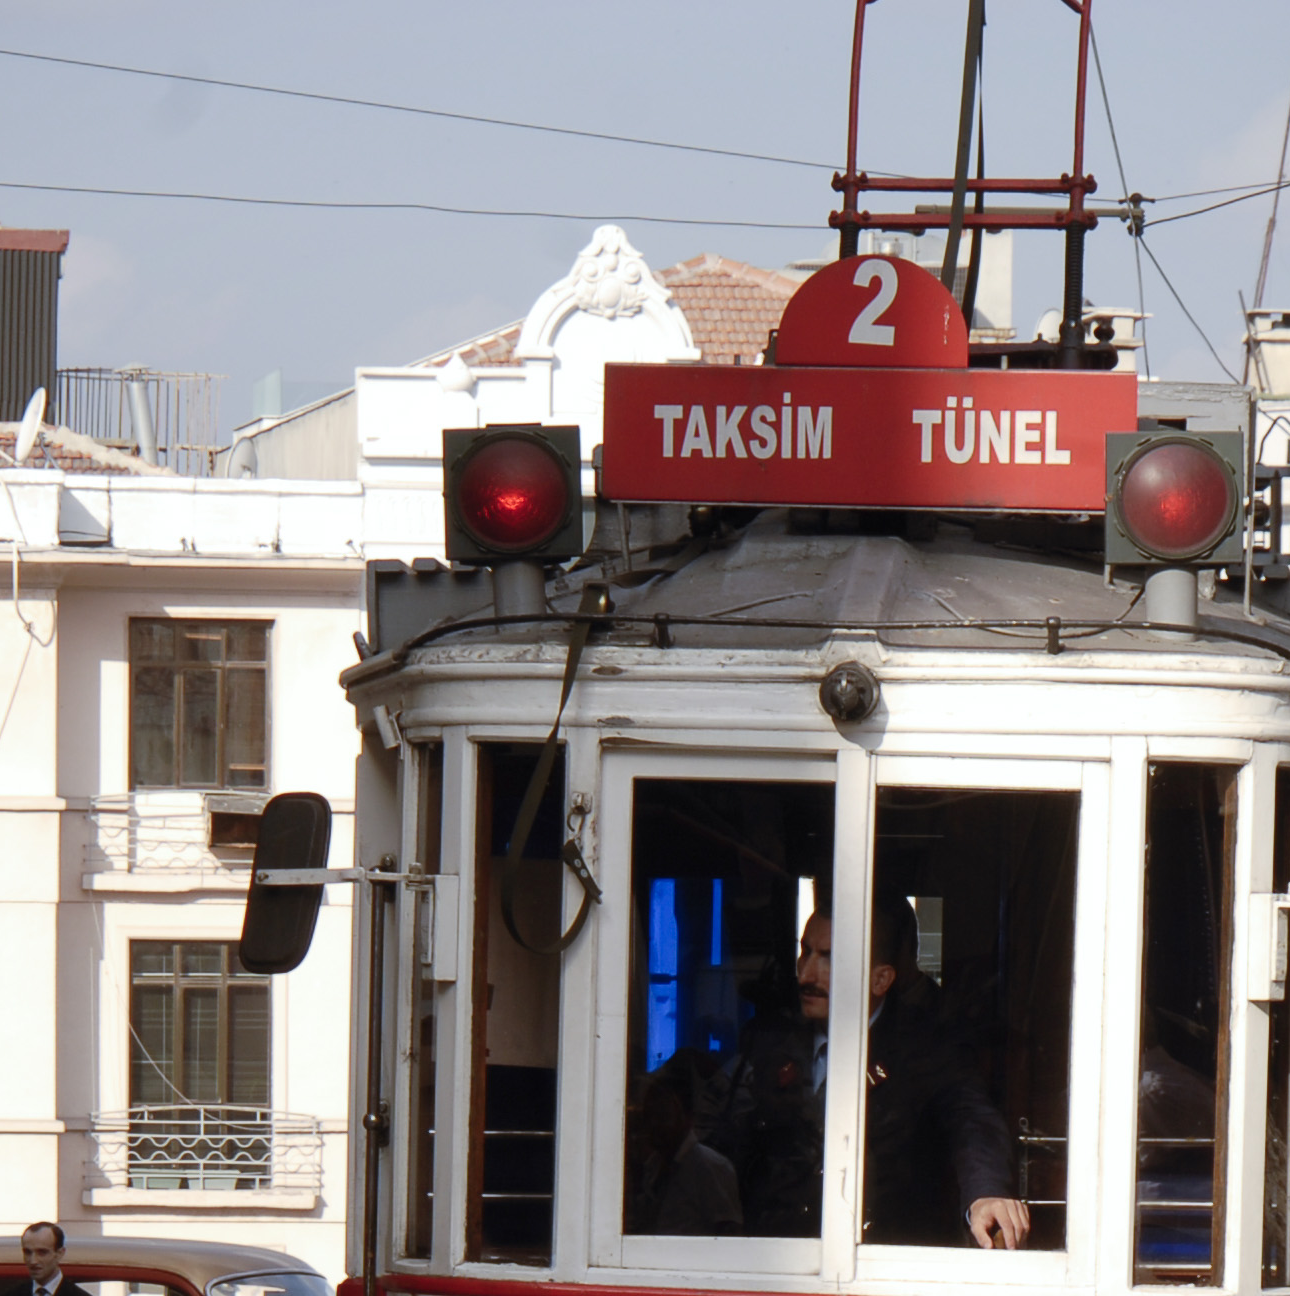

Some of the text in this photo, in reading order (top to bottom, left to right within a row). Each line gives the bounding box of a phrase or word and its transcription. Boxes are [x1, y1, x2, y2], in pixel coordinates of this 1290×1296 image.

[847, 258, 899, 347] 2
[654, 392, 1072, 465] TAKSİM TÜNEL
